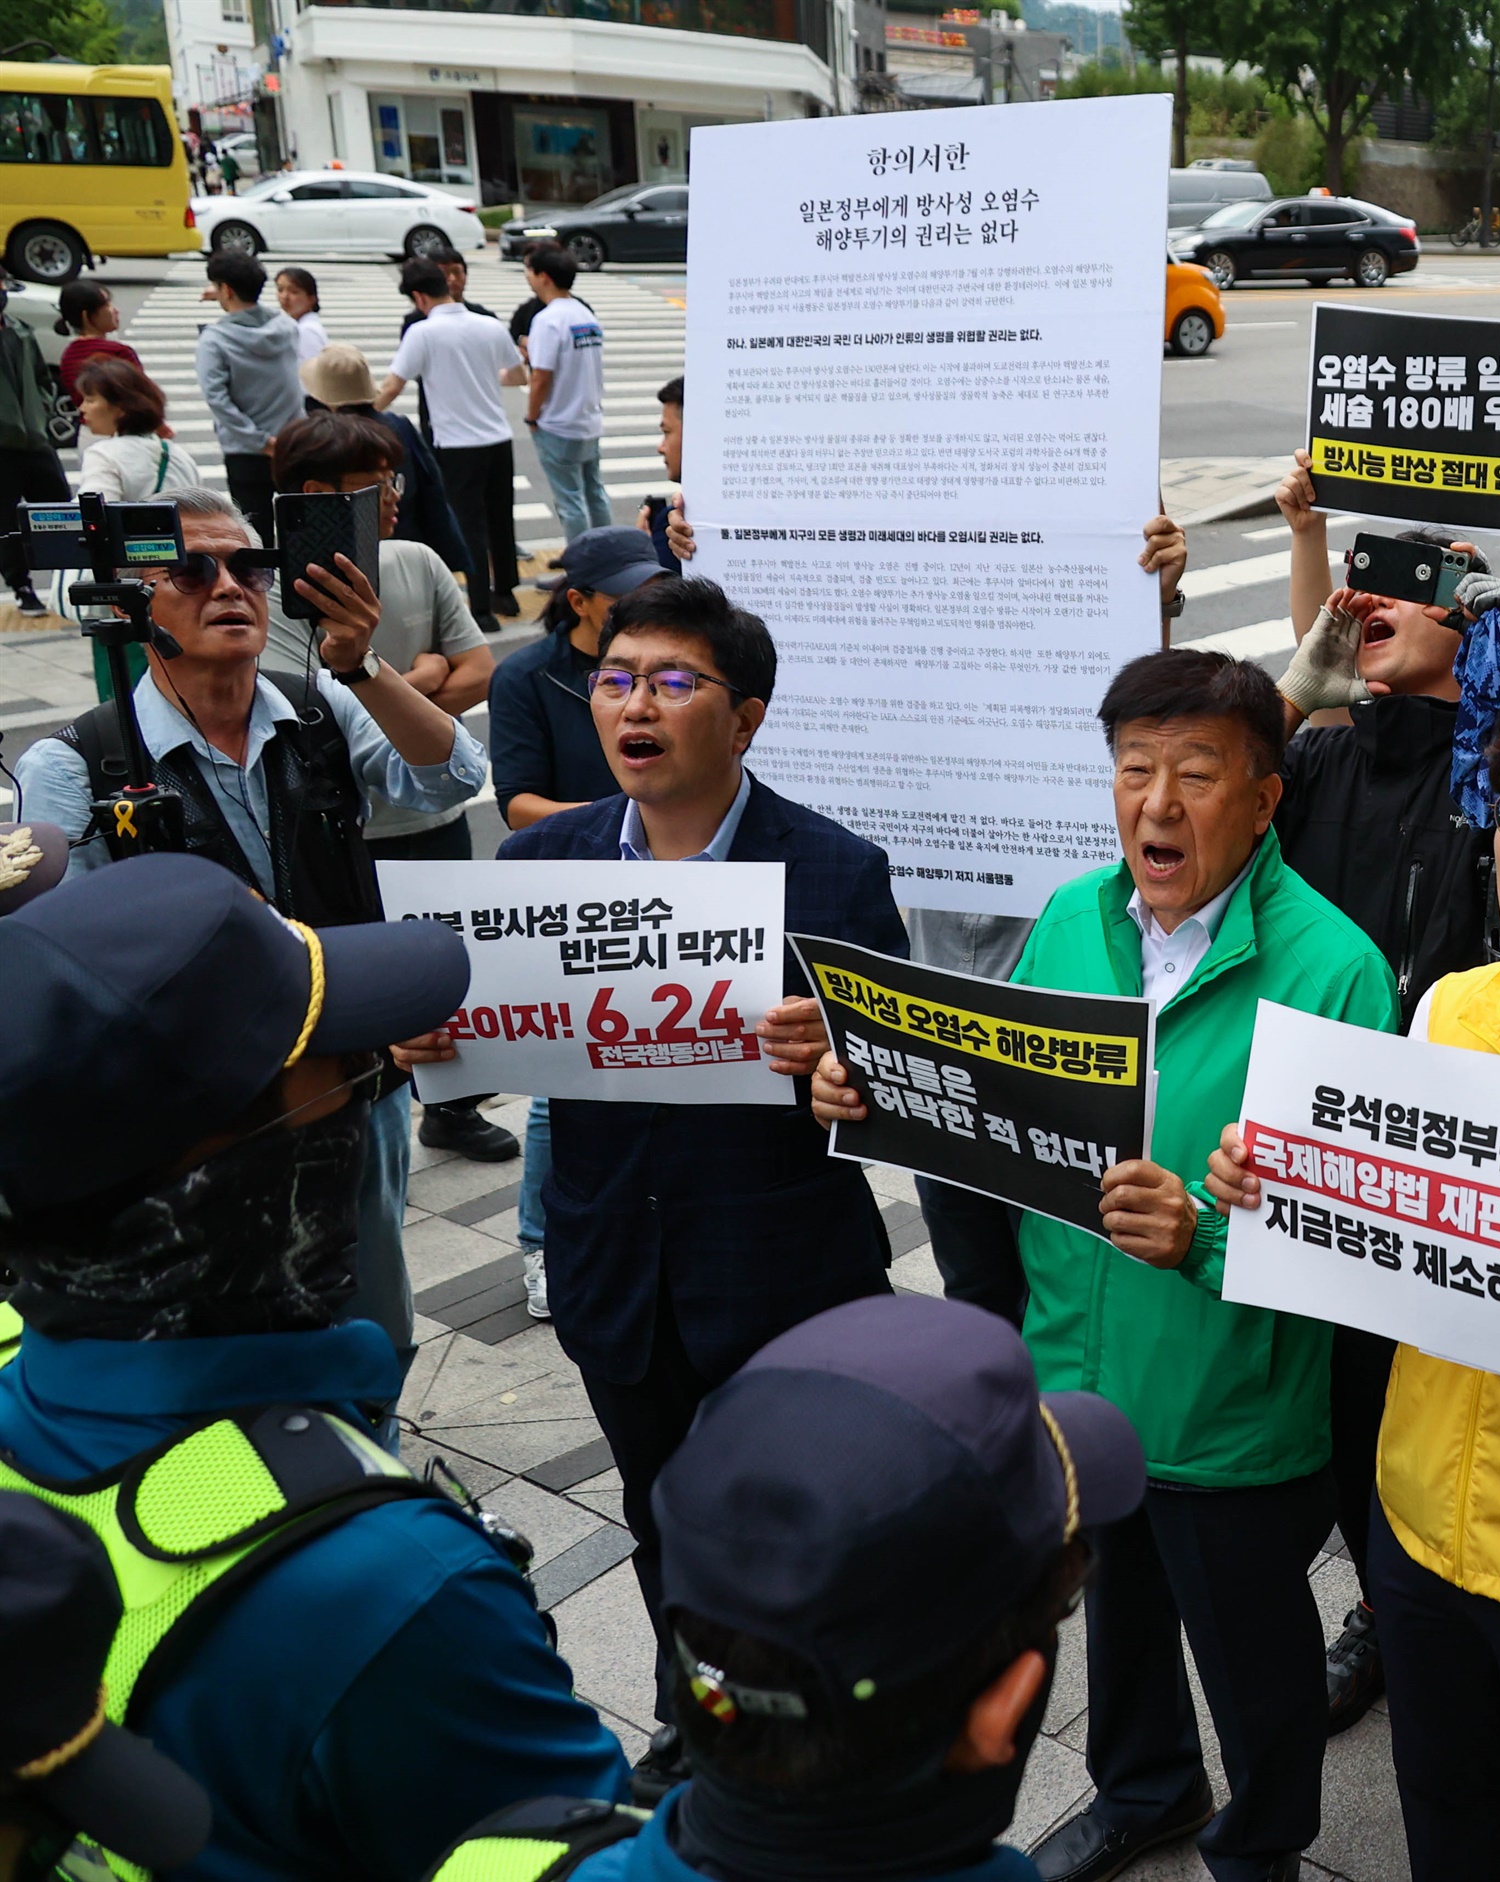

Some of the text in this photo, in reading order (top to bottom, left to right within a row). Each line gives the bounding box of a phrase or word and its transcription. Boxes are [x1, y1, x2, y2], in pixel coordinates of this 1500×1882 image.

[868, 142, 970, 176] 항의서한
[800, 188, 1039, 223] 일본정부에게 방사성 오염수
[816, 219, 1019, 252] 해양투기의 권리는 없다
[727, 328, 1042, 350] 하나. 일본에게 대한민국의 국민 더 나아가 인류의 생명을 위협할 권리는 없다.
[1317, 355, 1396, 391] 오염수
[1406, 356, 1466, 391] 방류
[1320, 393, 1373, 428] 세슘
[1383, 396, 1473, 430] 180배
[1324, 445, 1385, 478] 방사능
[1391, 454, 1437, 484] 밥상
[1442, 460, 1488, 490] 절대
[721, 528, 1043, 544] 둘. 일본정부에게 지구의 모든 생명과 미래세대의 바다를 오염시킬 권리는 없다.
[837, 805, 858, 817] 생명을
[862, 807, 899, 820] 일본정부와
[902, 810, 947, 823] 도쿄전력에게
[950, 813, 965, 824] 맡긴
[970, 814, 977, 825] 적
[980, 815, 997, 826] 없다.
[1000, 816, 1025, 828] 바다로
[1028, 818, 1052, 830] 들어간
[1056, 820, 1088, 833] 후쿠시마
[1091, 821, 1119, 835] 방사능
[848, 819, 877, 832] 대한민국
[879, 821, 909, 833] 국민이자
[912, 823, 934, 835] 지구의
[936, 825, 959, 837] 바다에
[962, 827, 985, 839] 더불어
[988, 829, 1019, 842] 살아가는
[1022, 831, 1030, 842] 한
[1033, 832, 1073, 845] 사람으로서
[1076, 835, 1117, 848] 일본정부의
[893, 835, 923, 847] 후쿠시마
[925, 838, 955, 850] 오염수를
[958, 840, 973, 852] 일본
[976, 841, 999, 853] 육지에
[1001, 843, 1033, 856] 안전하게
[1036, 846, 1060, 858] 보관할
[1063, 848, 1079, 859] 것을
[1082, 849, 1116, 862] 요구한다.
[889, 862, 1013, 886] 오염수 해양투기 저지 서울행동
[471, 903, 568, 941] 방사성
[576, 897, 673, 934] 오염수
[560, 927, 764, 975] 반드시 막자!
[587, 979, 746, 1043] 6.24
[823, 970, 1129, 1081] 방사성 오염수 해양방류
[598, 1037, 744, 1068] 전국행동의날
[845, 1029, 979, 1105] 국민들은
[867, 1079, 978, 1140] 허락한
[985, 1112, 1022, 1155] 적
[1251, 1132, 1431, 1222] 국제해양법
[1264, 1194, 1404, 1272] 지금당장
